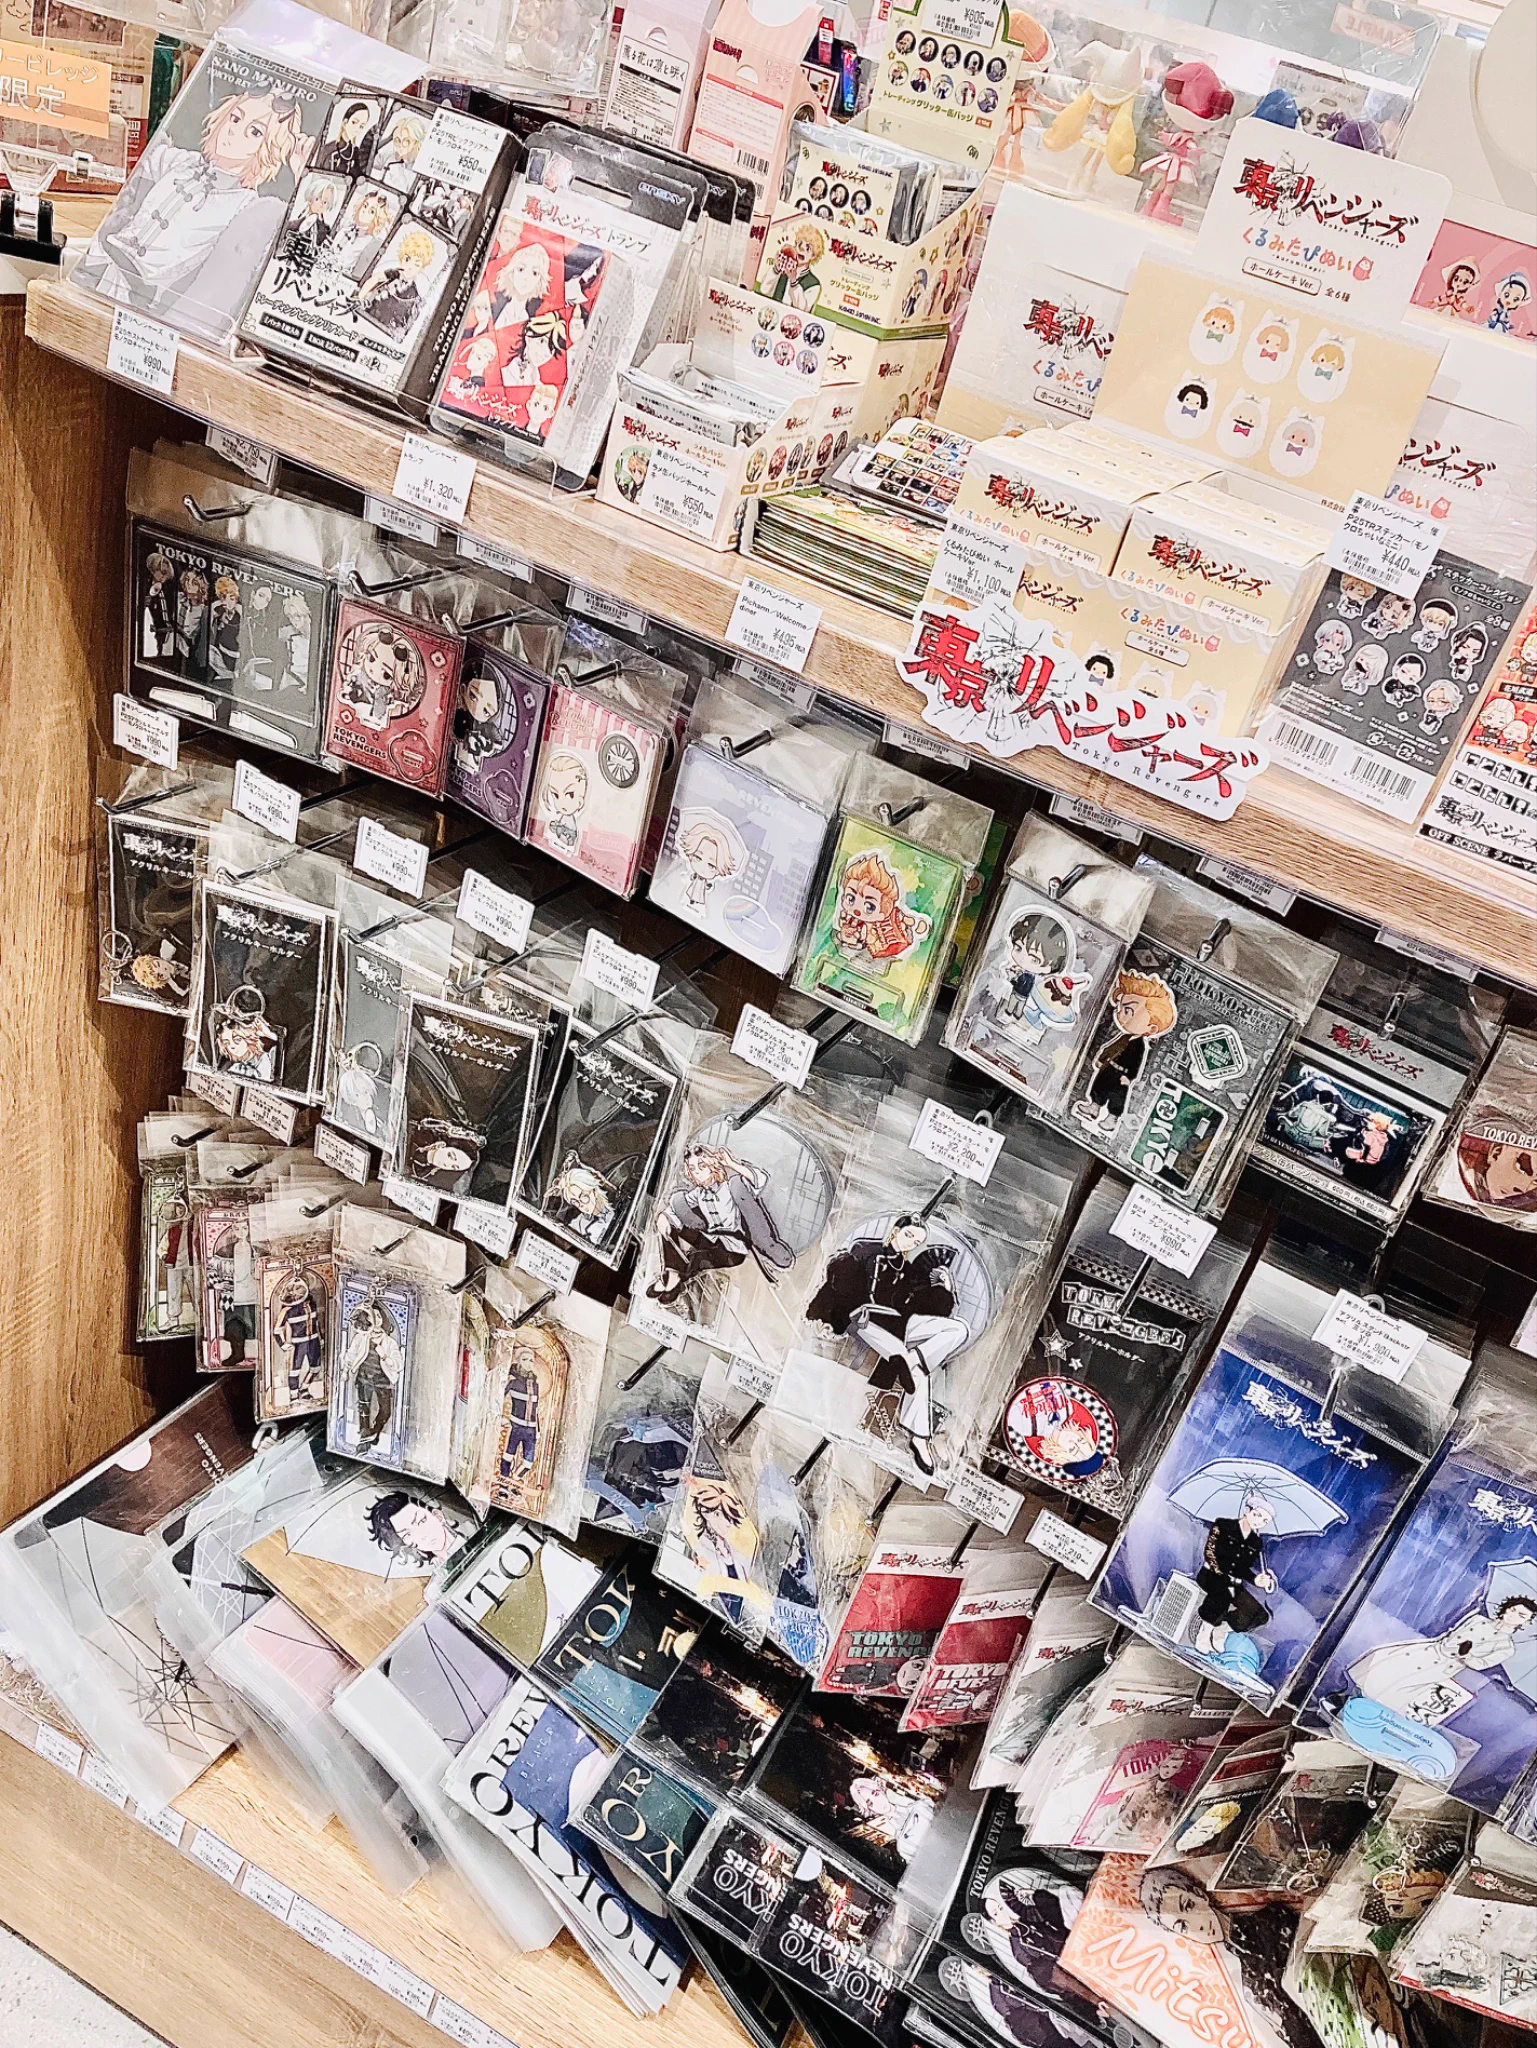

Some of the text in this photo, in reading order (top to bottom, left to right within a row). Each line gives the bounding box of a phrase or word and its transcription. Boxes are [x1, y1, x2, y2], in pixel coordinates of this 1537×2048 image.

[0, 48, 98, 84] ービレッジ
[212, 55, 317, 103] SANO MANJIRO
[621, 44, 686, 82] 薫る花は凛と咲く
[0, 75, 66, 117] 限定
[458, 154, 480, 172] ¥550
[1233, 157, 1420, 244] 東京リベンジャーズ
[606, 229, 652, 254] トランプ
[1242, 226, 1354, 273] くるみたぴぬい
[1250, 260, 1299, 285] ホールケーキ
[432, 300, 458, 353] TOKYO
[143, 353, 163, 372] ¥990
[655, 448, 710, 480] 東京リベンジャーズ
[1400, 438, 1497, 487] ンジャーズ
[423, 476, 454, 501] ¥1,320
[682, 494, 705, 515] ¥550
[983, 473, 1101, 535] 東京リベンジャーズ
[1354, 495, 1426, 531] 東京リベンジャーズ
[945, 538, 991, 564] くるみたぴぬい
[950, 521, 1010, 554] 東京リベンジャーズ
[1041, 537, 1084, 557] ホールケーキ
[155, 542, 306, 599] TOKYO REVENGERS
[1147, 534, 1271, 598] 東京リベンジャーズ
[1381, 548, 1411, 572] ¥440
[966, 566, 1002, 593] ¥1,100
[1017, 569, 1084, 613] ベンジャーズ
[739, 605, 758, 618] diner
[747, 580, 806, 612] 東京リベンジャーズ
[772, 627, 797, 649] ¥495
[1120, 607, 1204, 645] くるみたぴぬい
[902, 610, 1260, 799] 東京リベンジャーズ
[332, 725, 367, 746] TOKYO
[332, 732, 388, 761] REVENGERS
[1070, 740, 1221, 809] Tokyo Revengers
[1428, 827, 1451, 843] OFF
[1451, 835, 1490, 858] SCENE
[391, 861, 408, 877] ¥990
[495, 913, 513, 931] ¥990
[619, 973, 638, 991] ¥990
[947, 1139, 978, 1163] ¥2,200
[1482, 1125, 1518, 1145] TOKYO
[1159, 1232, 1182, 1252] ¥990
[1061, 1282, 1124, 1313] TOK
[1066, 1305, 1186, 1351] REVNGERS
[1077, 1331, 1146, 1364] アクリルキーホルダー
[193, 1431, 226, 1477] VENGERS
[201, 1458, 223, 1486] OKYO
[876, 1551, 971, 1575] 東京リベンジーズ
[850, 1631, 923, 1647] TOKYO
[485, 1686, 551, 1770] REV
[969, 1797, 1012, 1899] TOKYO REVENG
[712, 1863, 776, 1923] KYO
[788, 1913, 893, 1992] REVENGERS
[779, 1928, 890, 2018] TOKYO
[1086, 1924, 1254, 2048] Mitsu
